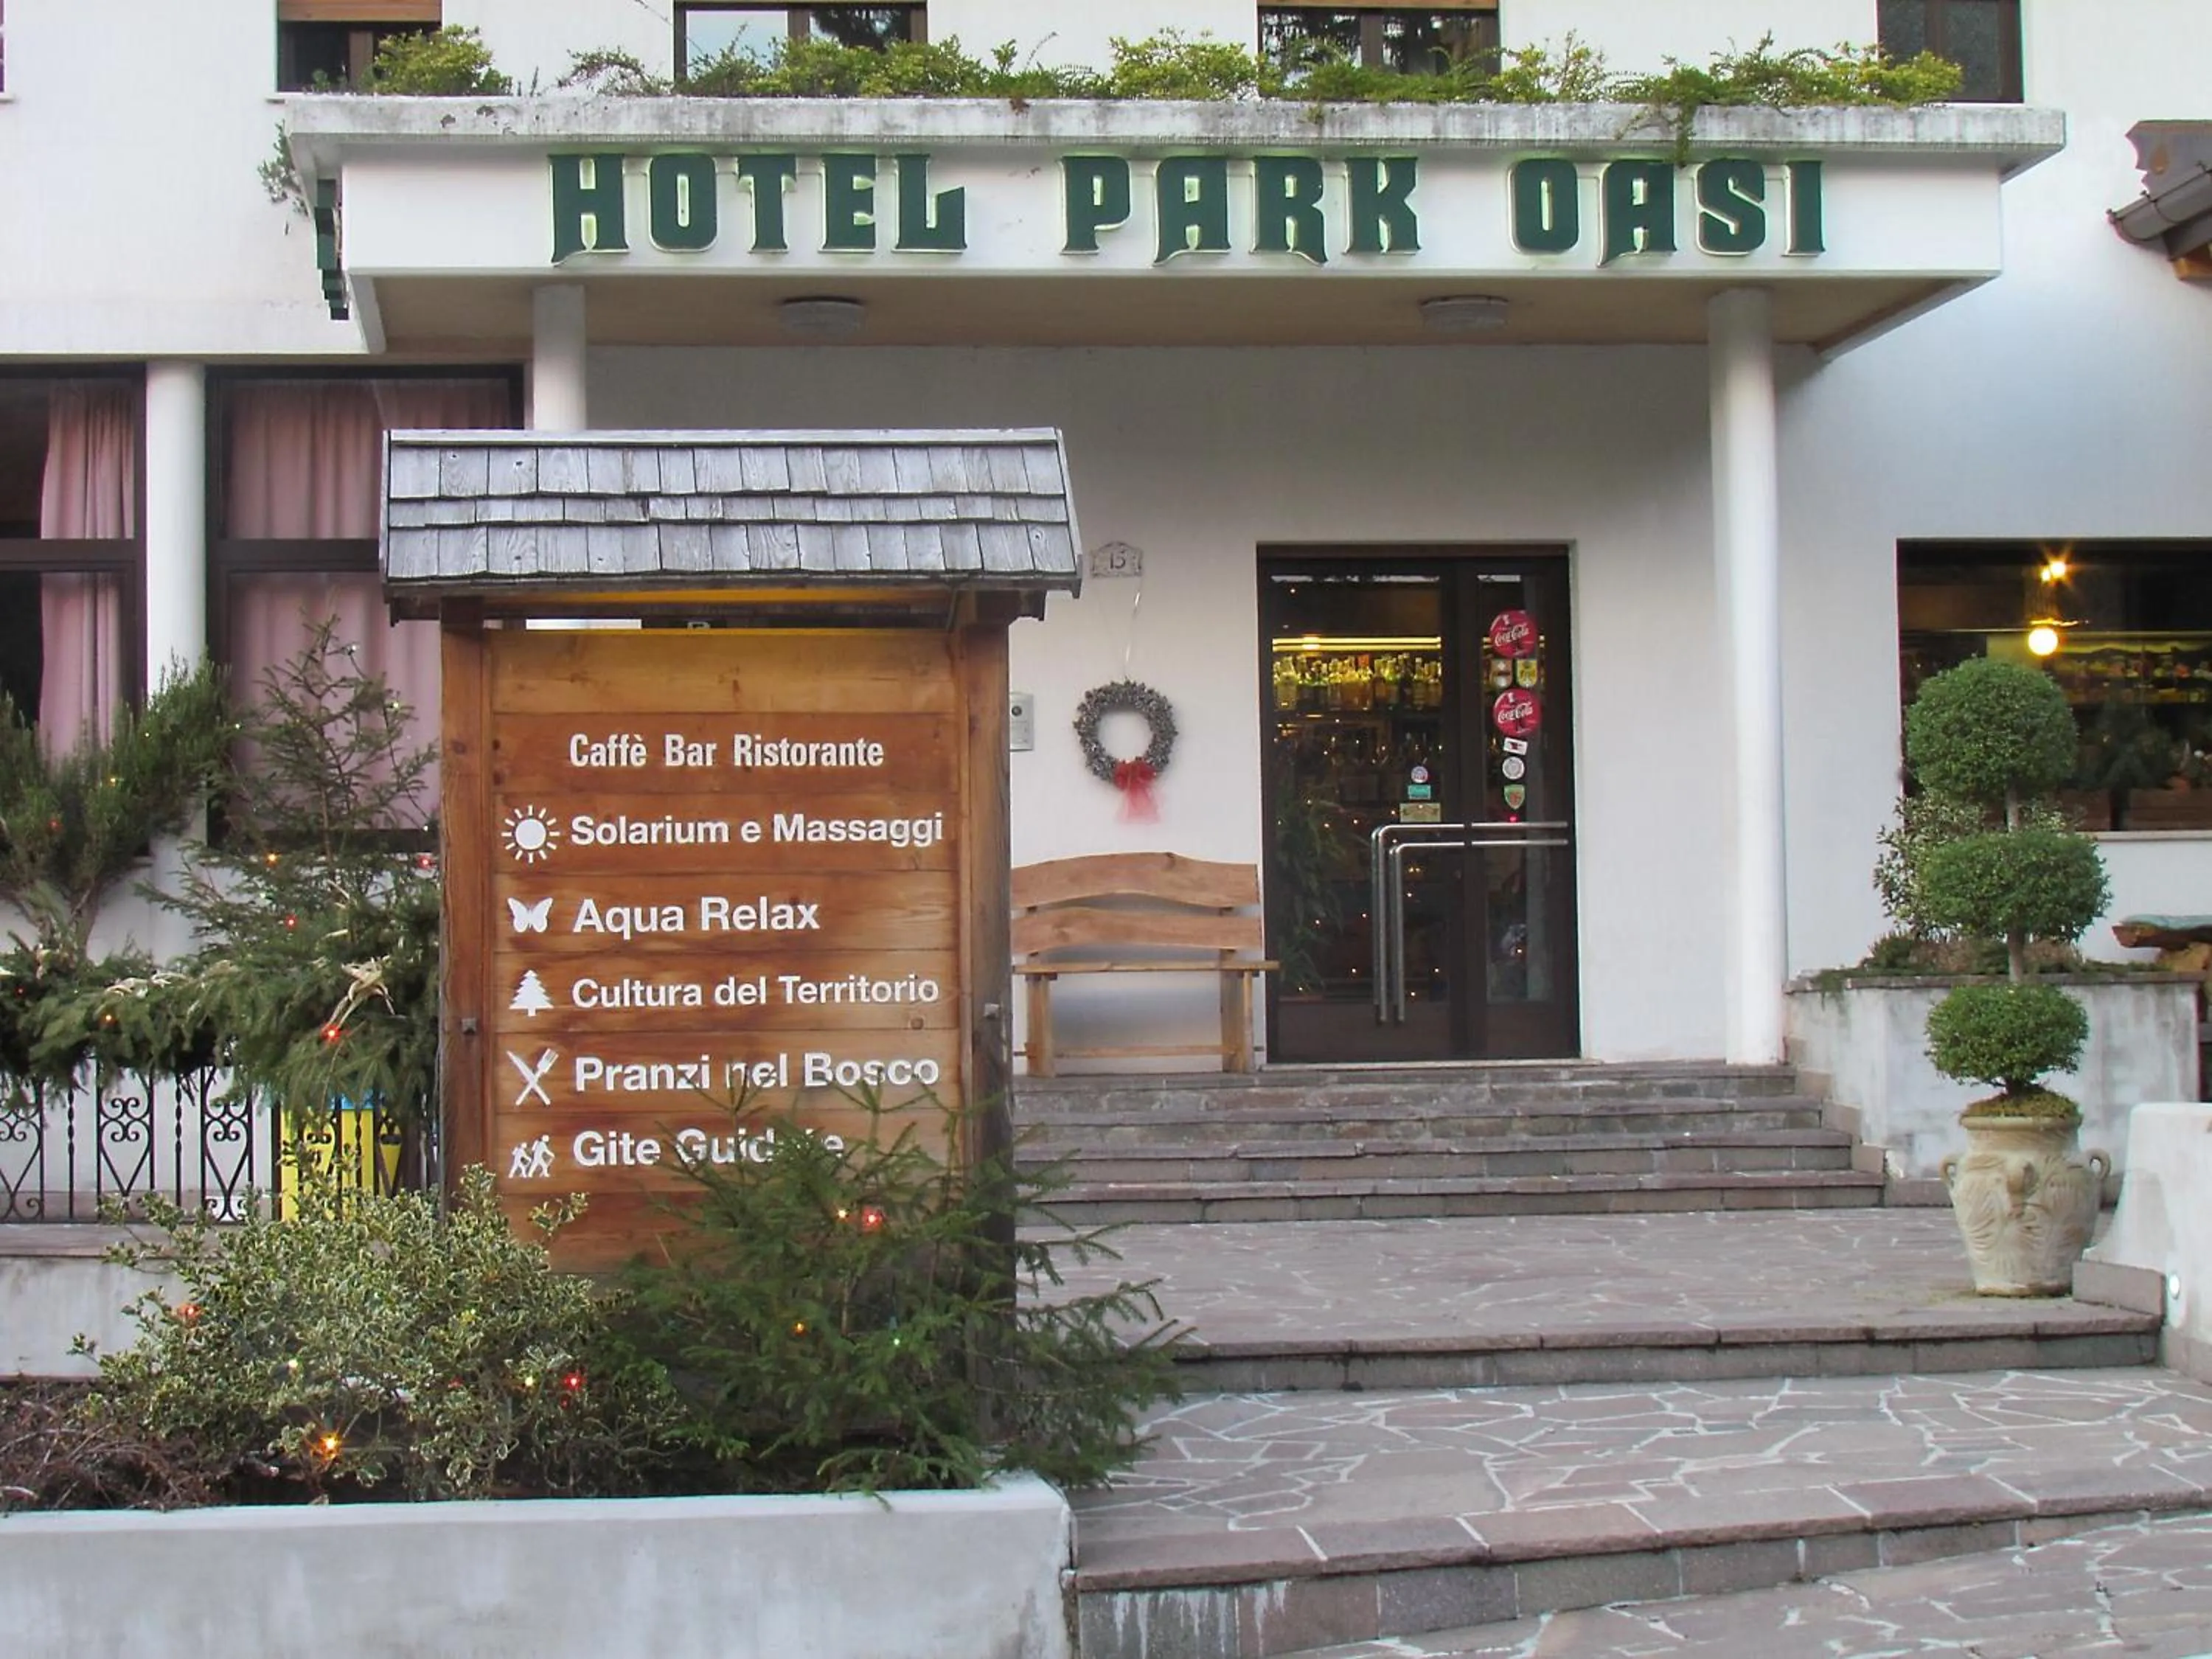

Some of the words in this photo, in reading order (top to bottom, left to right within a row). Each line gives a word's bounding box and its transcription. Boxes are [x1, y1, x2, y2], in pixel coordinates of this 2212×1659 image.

[548, 153, 967, 266] HOTEL
[1058, 155, 1419, 267] PARK
[1506, 158, 1825, 268] OASI
[569, 734, 647, 768] Caffè
[664, 734, 717, 768] Bar
[733, 734, 885, 768] Ristorante
[571, 815, 730, 846] Solarium
[740, 821, 761, 843] e
[772, 812, 944, 849] Massaggi
[572, 898, 685, 940] Aqua
[700, 896, 821, 931] Relax
[571, 978, 703, 1008] Cultura
[714, 976, 767, 1005] del
[778, 973, 939, 1005] Territorio
[575, 1054, 710, 1092] Pranzi
[725, 1052, 788, 1089] nel
[804, 1051, 939, 1088] Bosco
[572, 1130, 661, 1167] Gite
[675, 1127, 845, 1167] Guide
